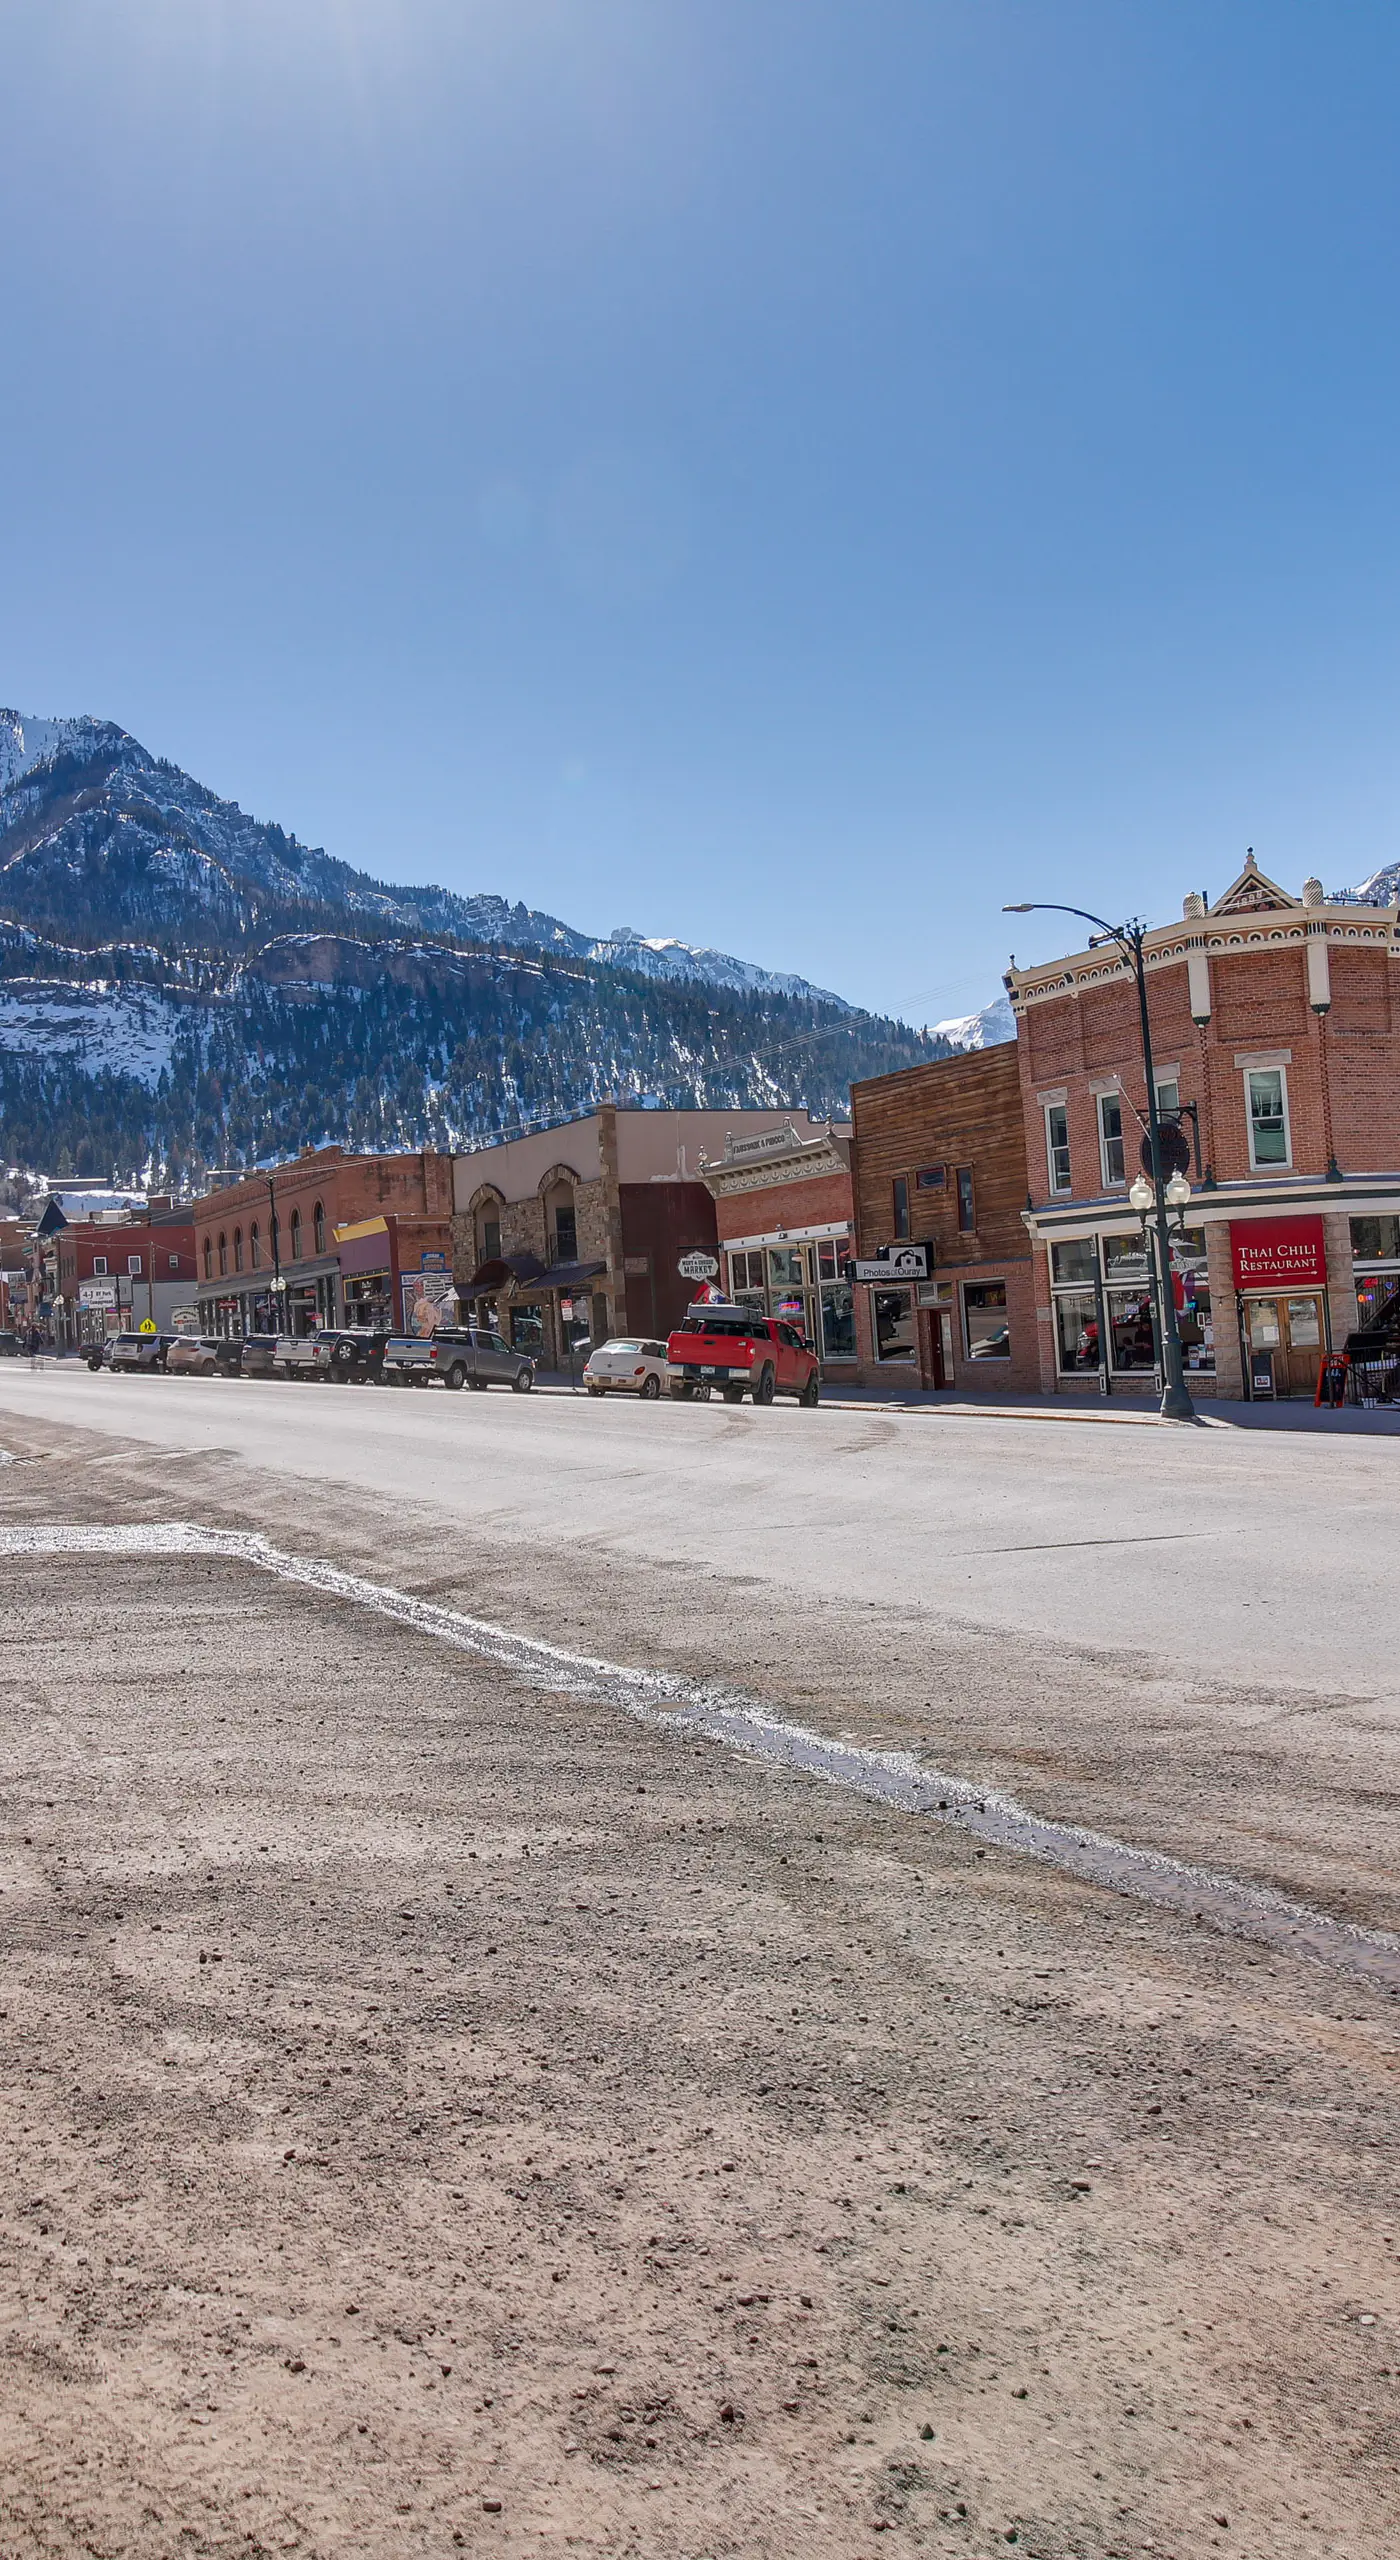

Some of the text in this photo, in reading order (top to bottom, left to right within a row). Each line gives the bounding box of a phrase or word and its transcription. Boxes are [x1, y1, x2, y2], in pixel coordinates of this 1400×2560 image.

[684, 1265, 713, 1274] MARKET
[863, 1268, 890, 1277] Photos
[897, 1267, 921, 1278] Ouray
